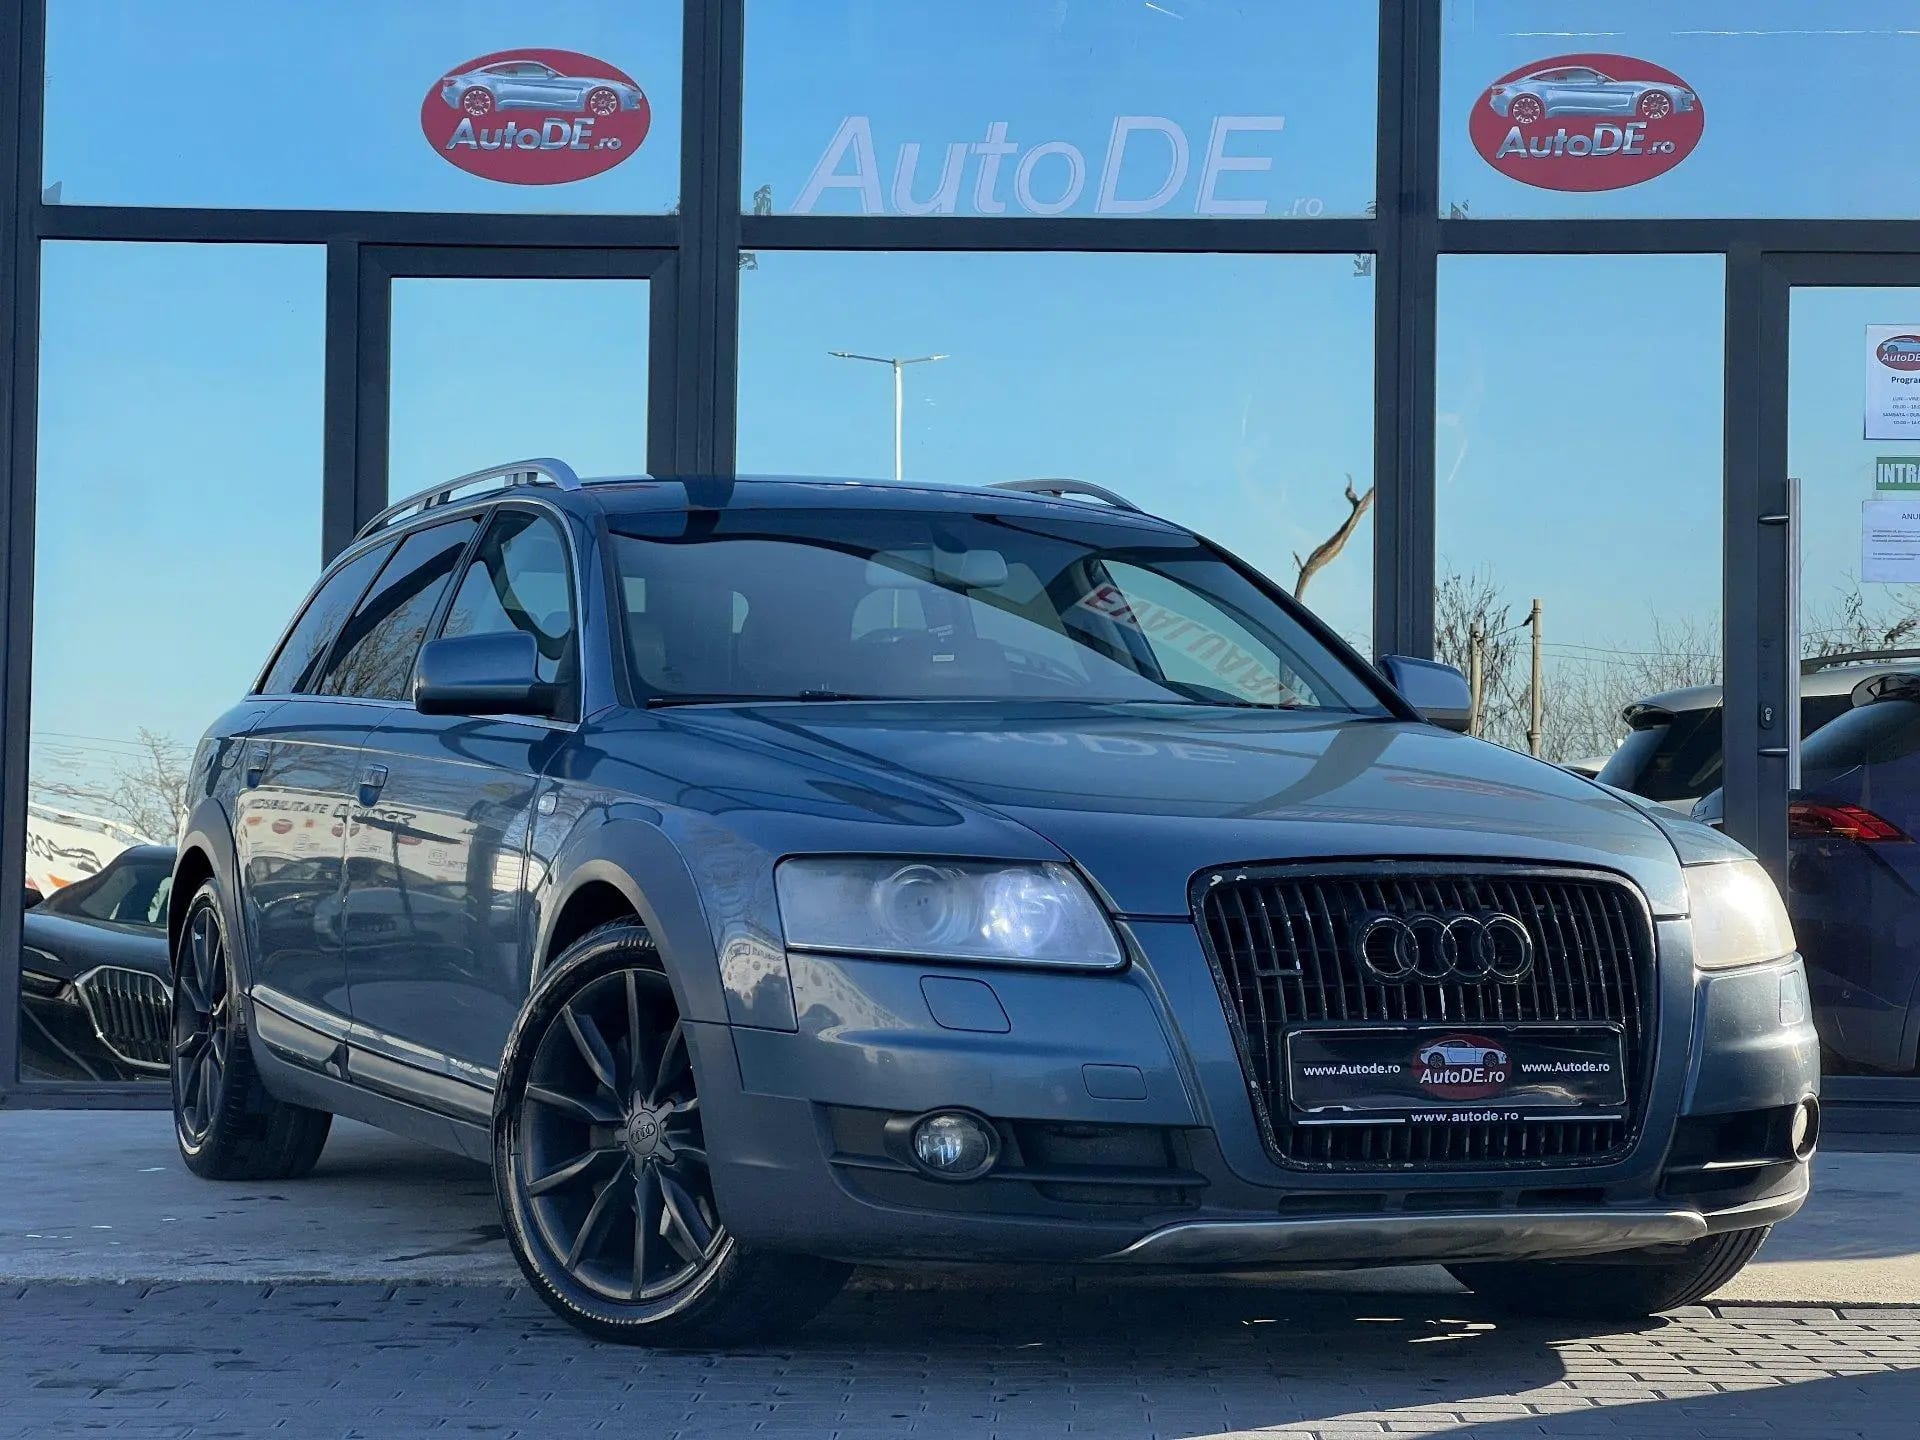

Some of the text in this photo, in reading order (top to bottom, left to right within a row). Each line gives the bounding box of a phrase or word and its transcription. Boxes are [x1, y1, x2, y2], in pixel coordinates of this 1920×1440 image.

[1891, 376, 1920, 385] Progra
[1303, 1063, 1401, 1076] www.Autode.ro
[1521, 1060, 1611, 1073] www.Autode.ro
[1419, 1067, 1506, 1085] AutoDE.ro
[1410, 1110, 1519, 1123] www.autode.ro
